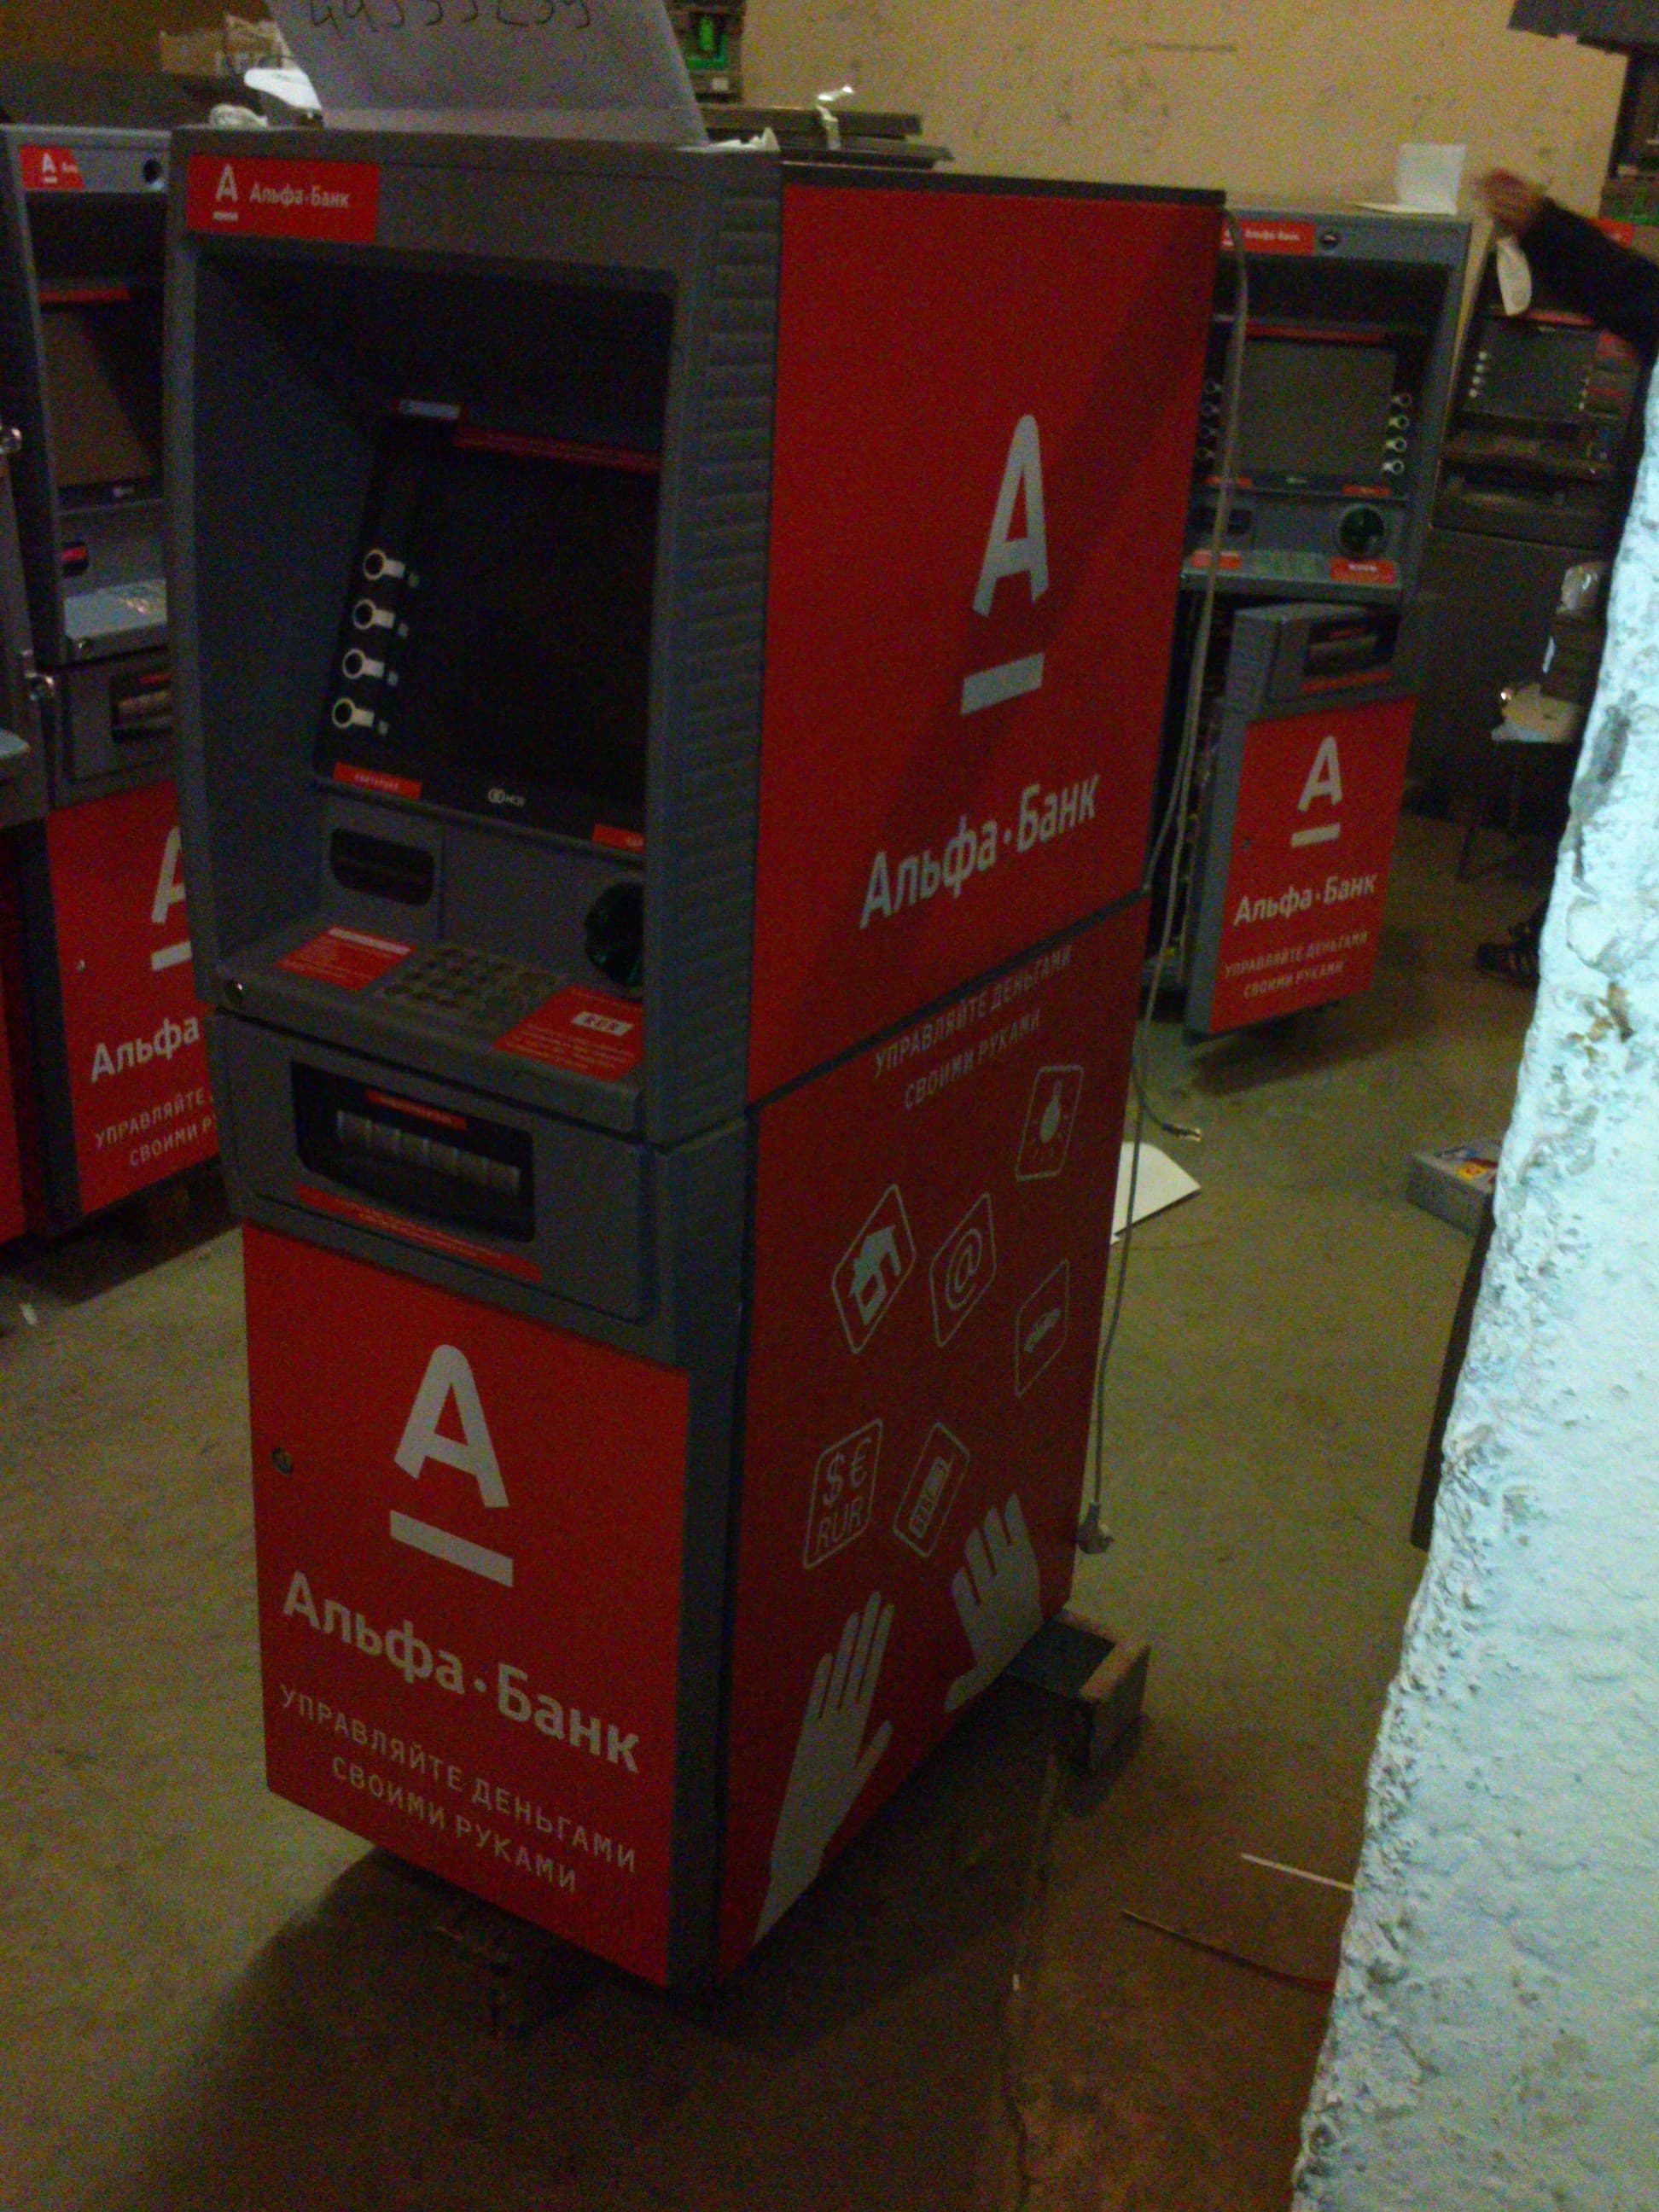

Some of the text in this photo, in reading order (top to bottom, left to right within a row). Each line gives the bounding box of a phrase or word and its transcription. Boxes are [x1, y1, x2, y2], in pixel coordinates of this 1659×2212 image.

[95, 1087, 205, 1150] УПРАВЛЯЙТЕ
[130, 1125, 198, 1167] СВОИМИ
[280, 1684, 636, 1873] УПРАВЛЯЙТЕ ДЕНЬГАМИ
[332, 1756, 576, 1893] СВОИМИ РУКАМИ
